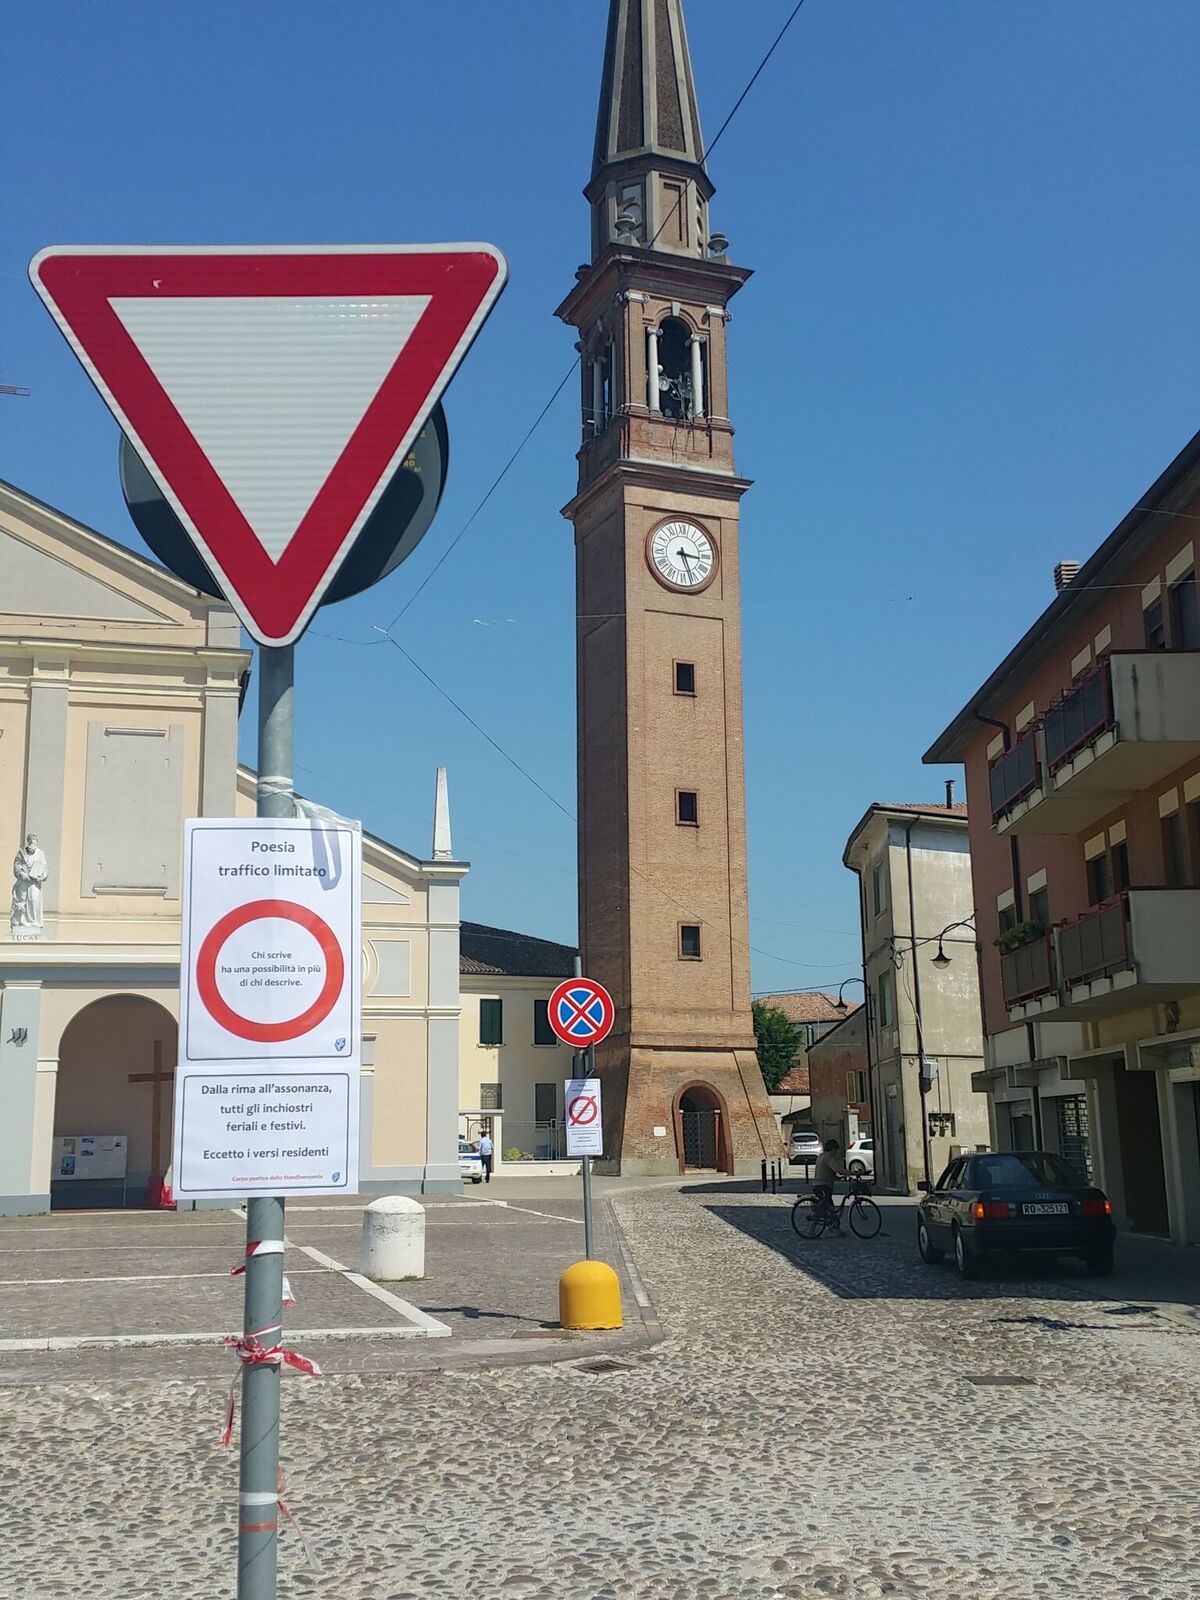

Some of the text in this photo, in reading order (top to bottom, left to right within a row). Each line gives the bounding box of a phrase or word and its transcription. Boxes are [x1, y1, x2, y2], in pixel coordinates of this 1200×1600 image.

[251, 841, 295, 853] Poesia
[218, 864, 327, 877] traffico limitato
[251, 951, 292, 959] Chi scrive
[221, 965, 232, 973] ha
[252, 965, 295, 975] possibilità
[297, 965, 306, 973] in
[307, 965, 321, 974] più
[240, 978, 303, 987] di chi descrive.
[201, 1085, 229, 1095] Dalla
[231, 1085, 256, 1094] rima
[220, 1103, 313, 1116] tutti gli inchiostri
[226, 1120, 306, 1131] feriali e festivi.
[203, 1150, 244, 1159] Eccetto
[253, 1148, 279, 1158] versi
[282, 1147, 329, 1157] residenti
